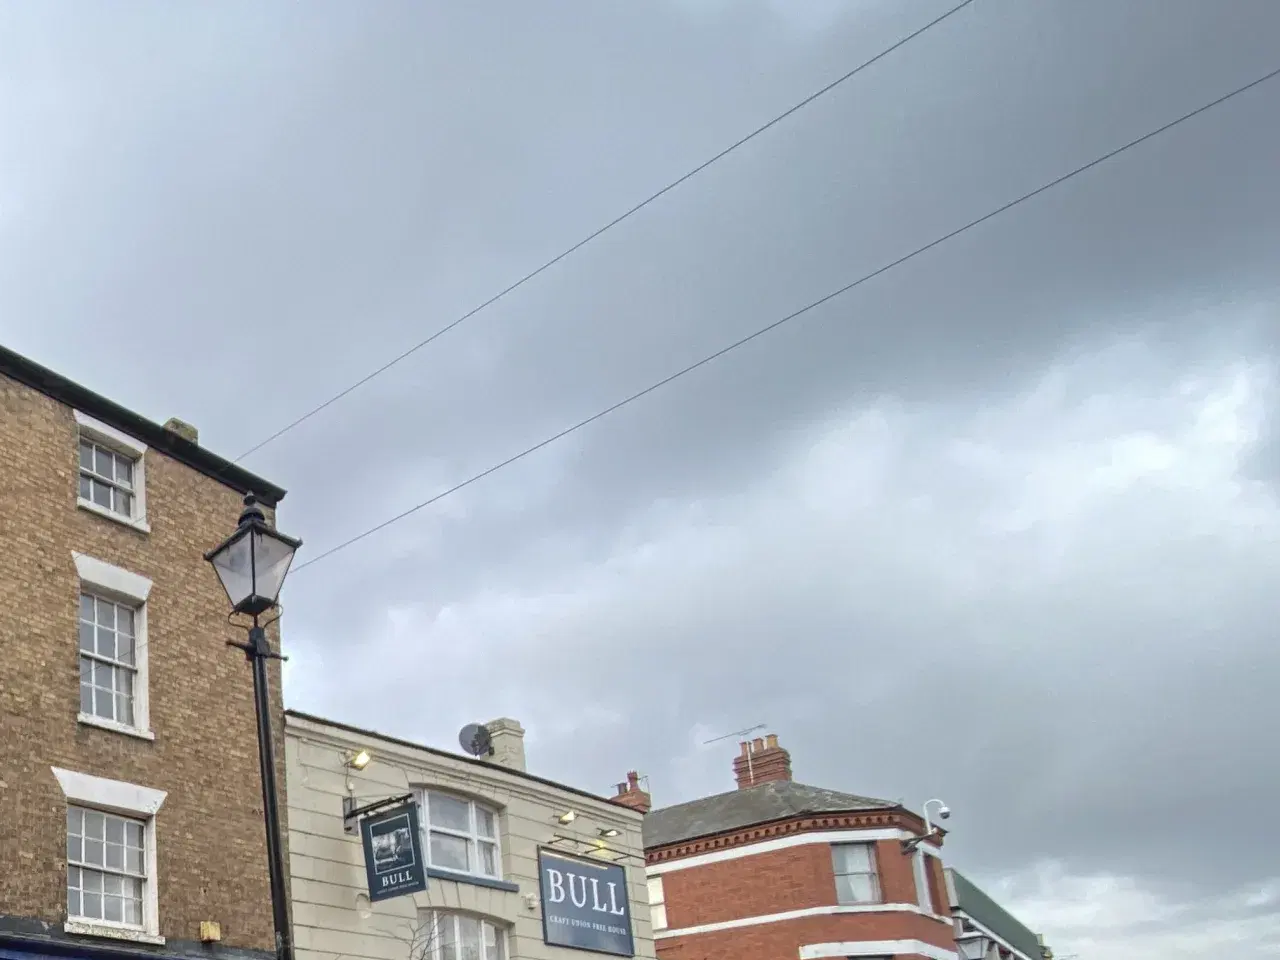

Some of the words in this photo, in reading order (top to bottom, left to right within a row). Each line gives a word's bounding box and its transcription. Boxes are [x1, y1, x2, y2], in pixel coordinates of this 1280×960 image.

[381, 870, 413, 887] BULL
[546, 868, 625, 915] BULL
[549, 915, 570, 925] CRAFT
[571, 918, 591, 929] UNION
[592, 922, 607, 933] FREE
[607, 925, 627, 936] HOUSE
